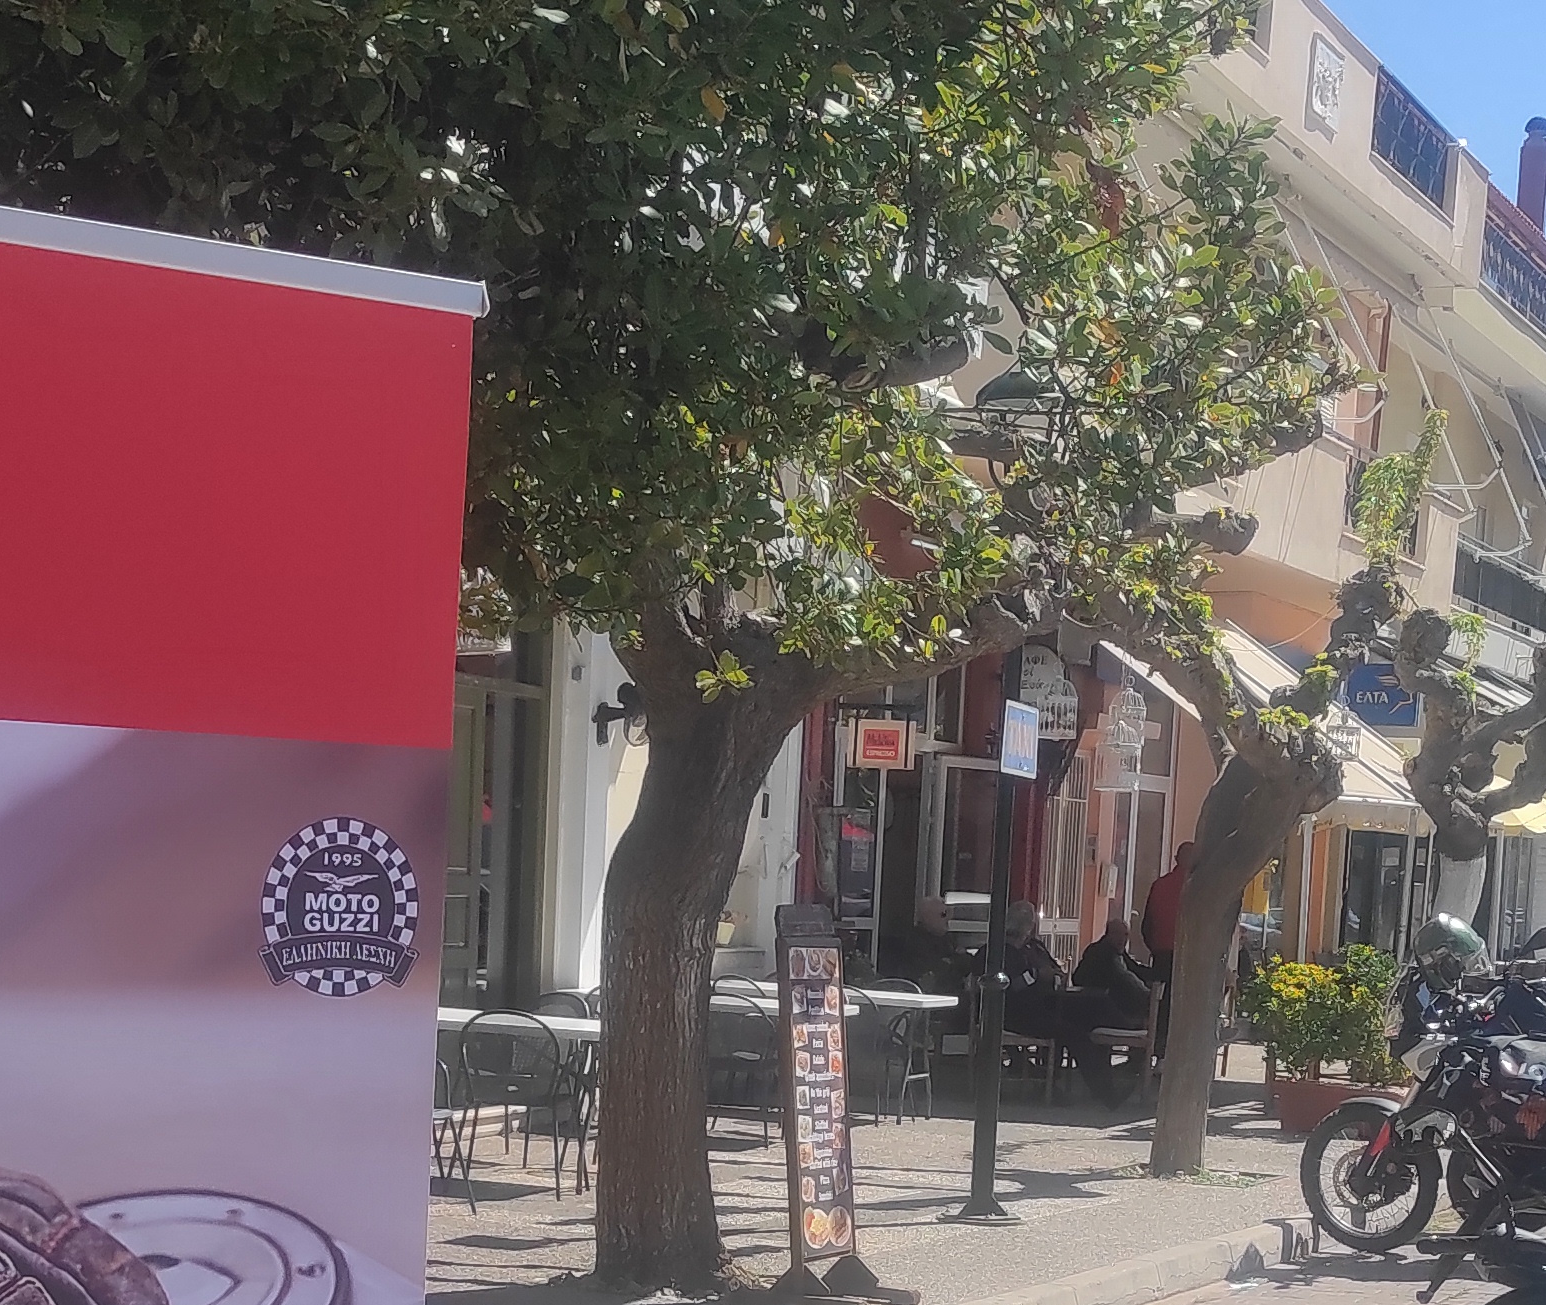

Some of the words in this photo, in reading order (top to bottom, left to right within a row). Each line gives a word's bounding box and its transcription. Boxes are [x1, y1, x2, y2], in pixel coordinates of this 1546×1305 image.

[1355, 690, 1389, 705] ΕΛΤΑ
[322, 851, 363, 867] 1995
[304, 892, 380, 913] MOTO
[302, 912, 380, 933] GUZZI
[281, 940, 351, 966] ΕΛΛΗΝΙΚΗ
[354, 941, 396, 968] ΛΕΣΧΗ
